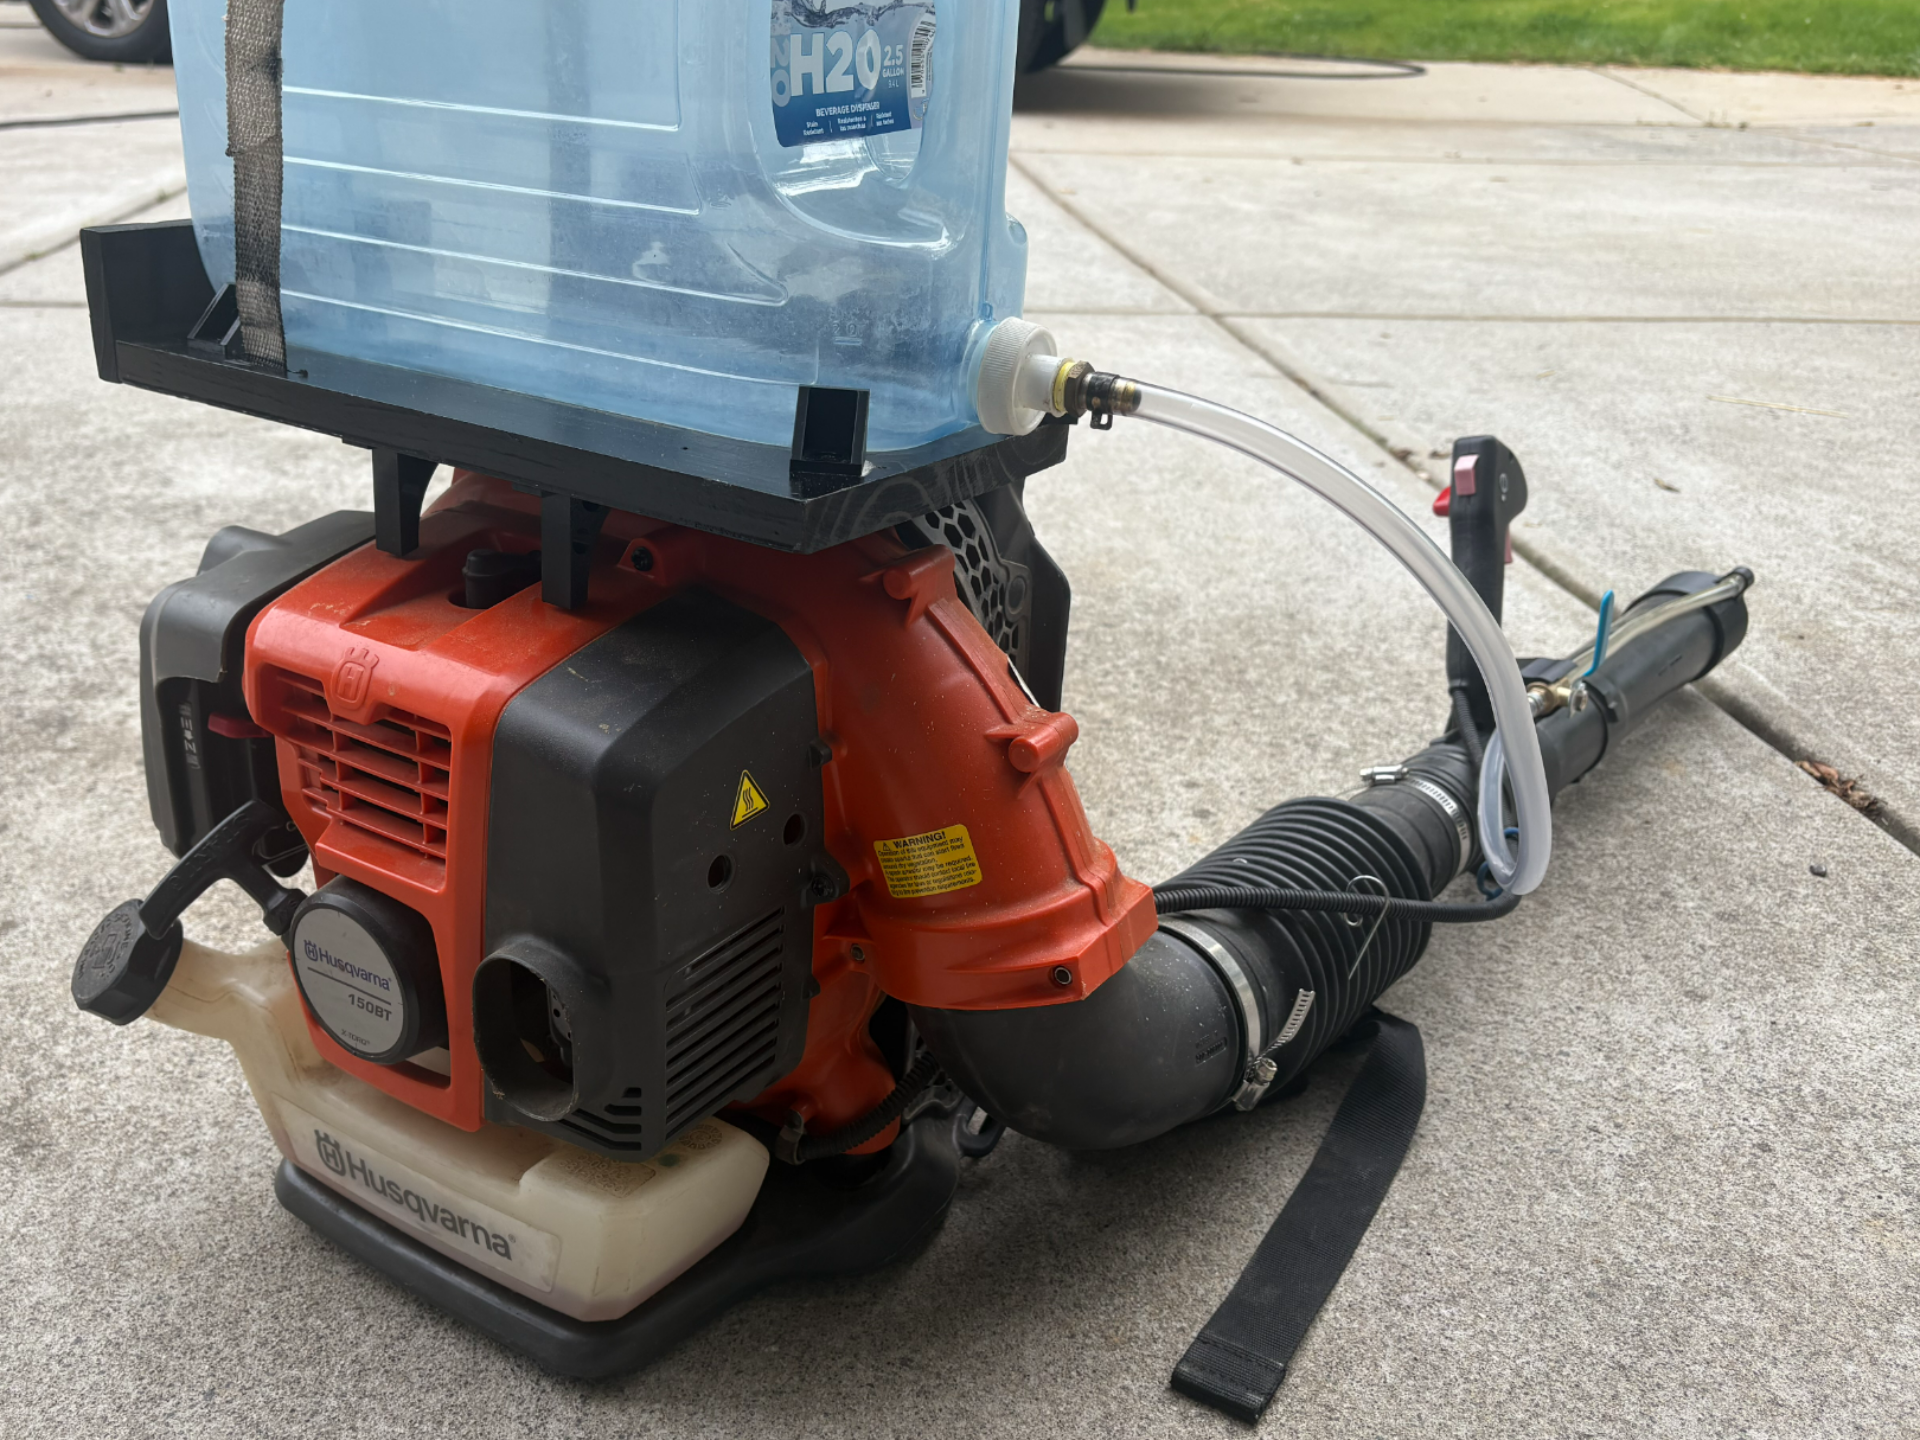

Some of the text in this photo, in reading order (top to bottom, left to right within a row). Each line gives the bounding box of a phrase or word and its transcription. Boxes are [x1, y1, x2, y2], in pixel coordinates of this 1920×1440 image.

[884, 45, 903, 66] 2.5
[883, 67, 904, 77] GALLON
[816, 105, 850, 117] BEVERAGE
[893, 831, 946, 849] WARNING!
[917, 840, 949, 853] equipment
[318, 947, 391, 991] Husqvarna
[348, 993, 392, 1021] 150BT
[345, 1151, 513, 1261] Husqvarna
